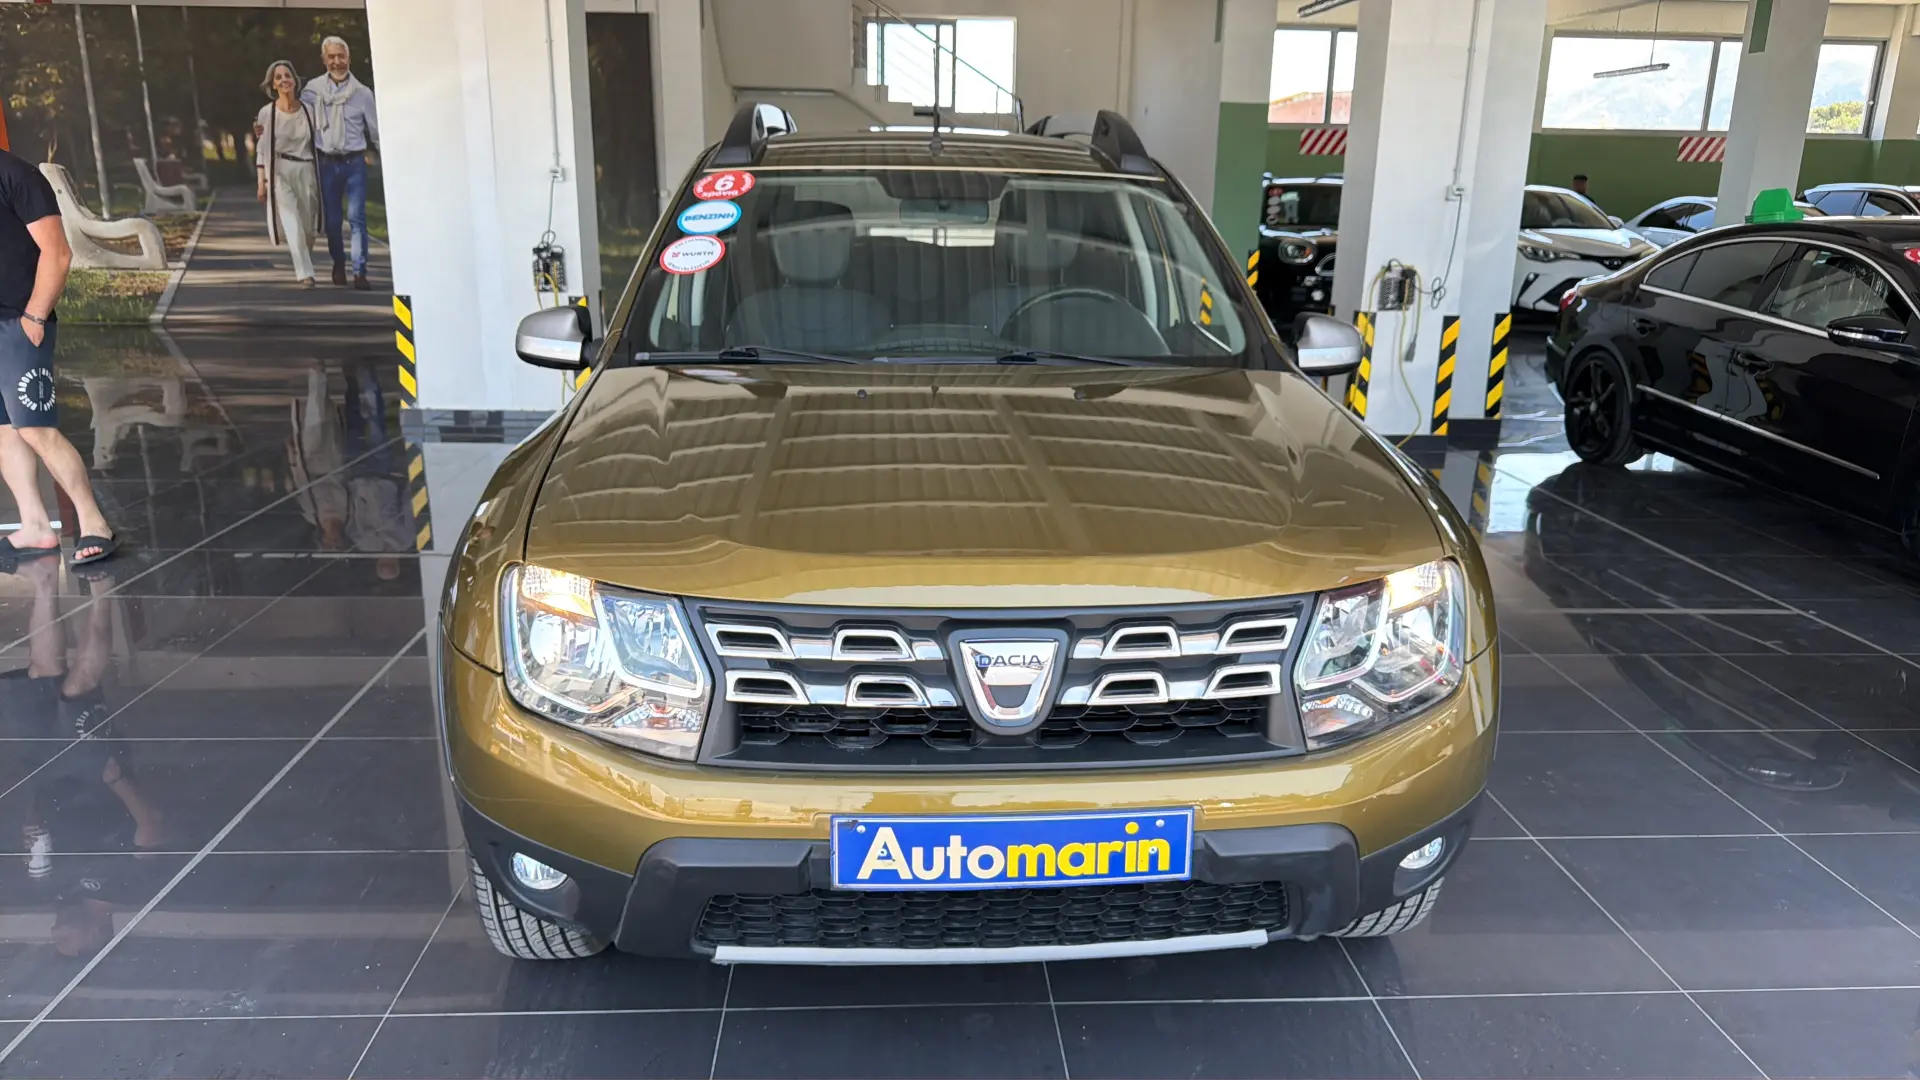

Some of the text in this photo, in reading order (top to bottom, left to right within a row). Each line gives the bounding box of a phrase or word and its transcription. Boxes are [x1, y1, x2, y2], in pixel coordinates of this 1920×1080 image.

[714, 174, 736, 191] 6
[17, 368, 38, 393] ABOVE
[979, 655, 1041, 666] DACIA
[856, 821, 1170, 881] Automarin
